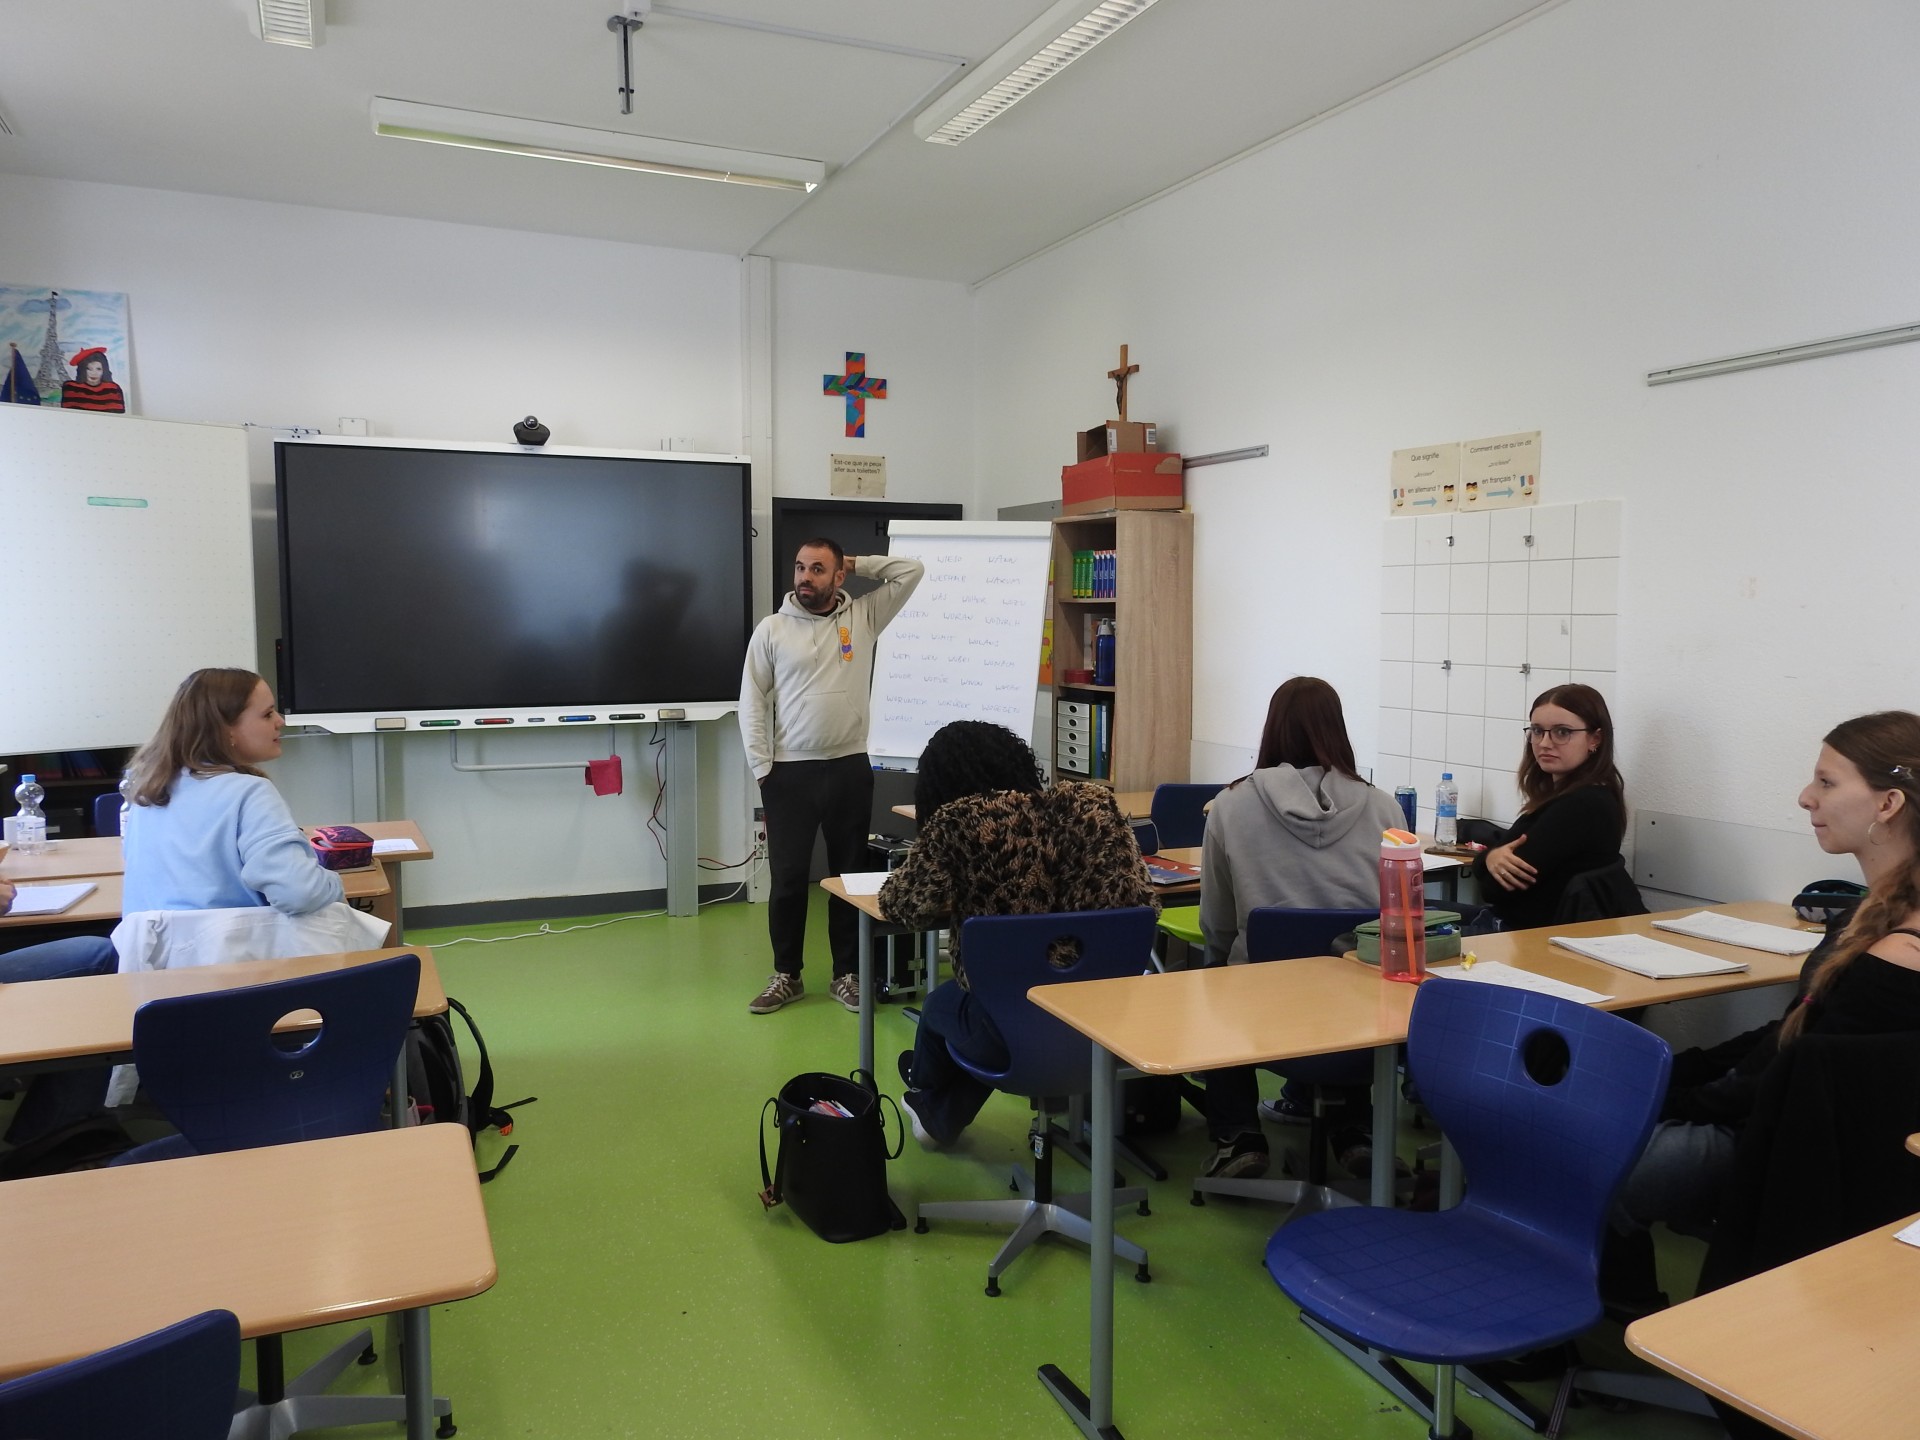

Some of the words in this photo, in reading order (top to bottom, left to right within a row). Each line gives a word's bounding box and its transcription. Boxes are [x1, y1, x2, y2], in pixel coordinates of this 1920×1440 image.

[1470, 445, 1493, 453] Comment
[1422, 452, 1440, 461] signifie
[1490, 476, 1511, 484] français
[1415, 485, 1436, 493] allemand
